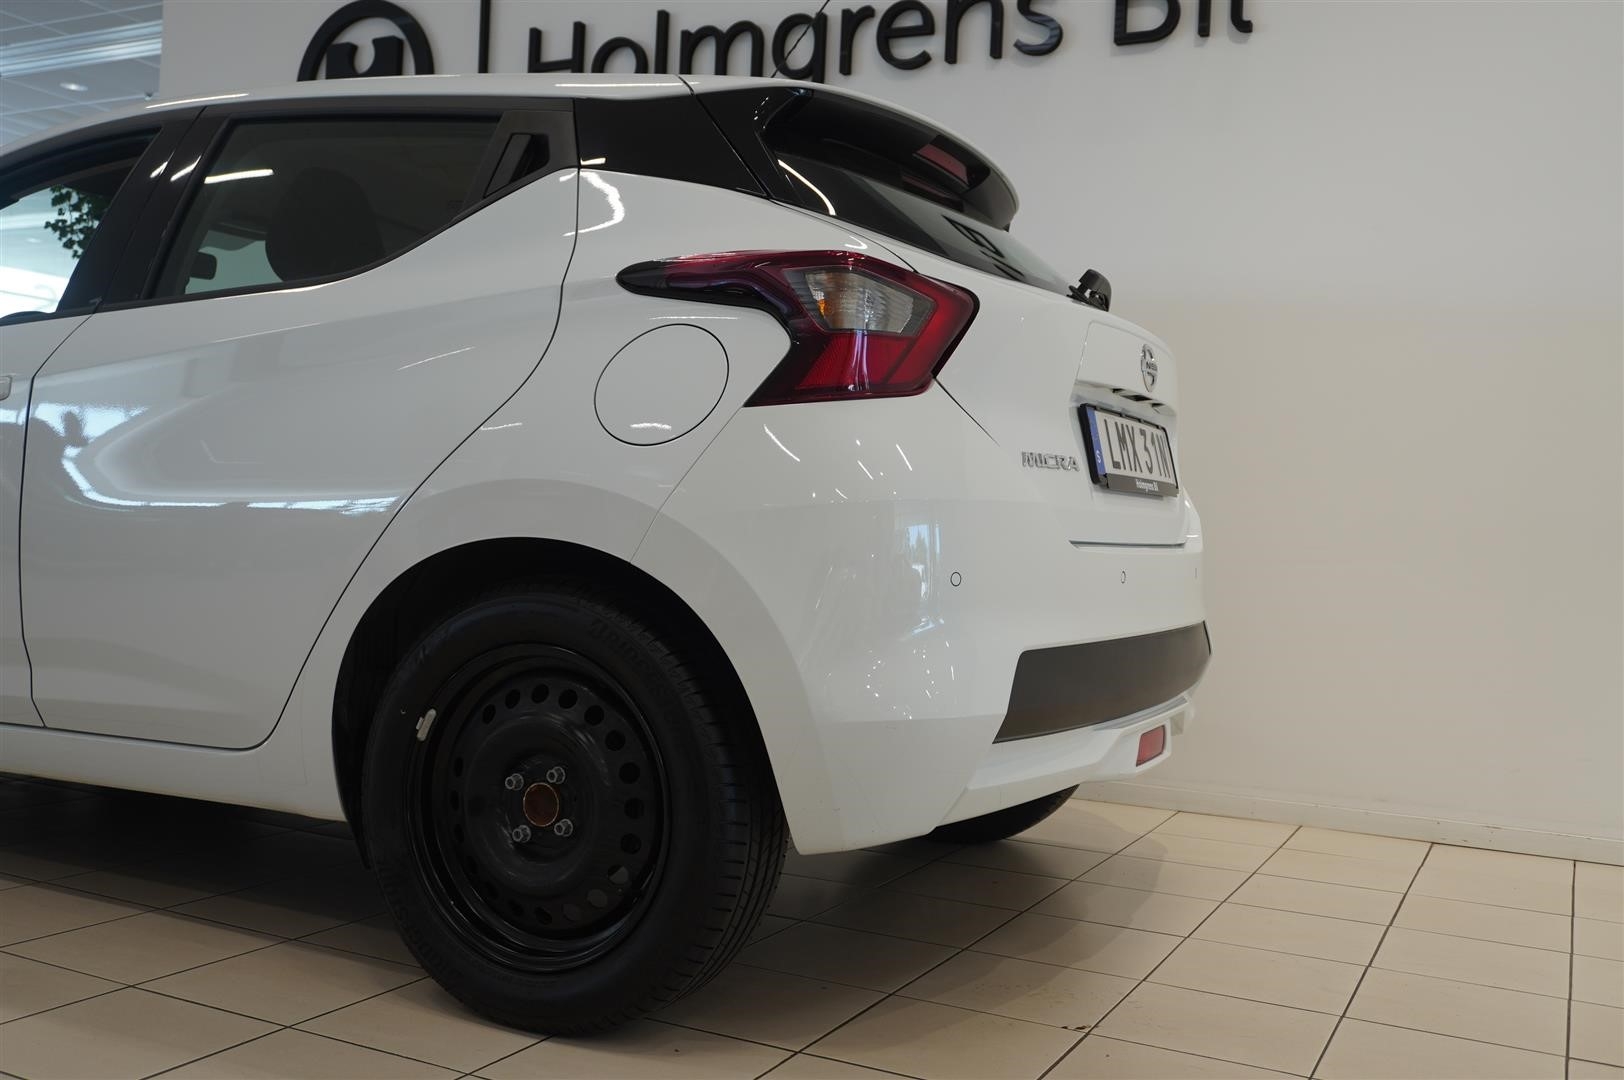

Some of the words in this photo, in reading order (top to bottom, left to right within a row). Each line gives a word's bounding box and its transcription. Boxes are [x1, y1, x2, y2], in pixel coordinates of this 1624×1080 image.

[1021, 451, 1080, 472] MICRA
[1104, 418, 1143, 474] LMX
[1139, 427, 1171, 479] 31N
